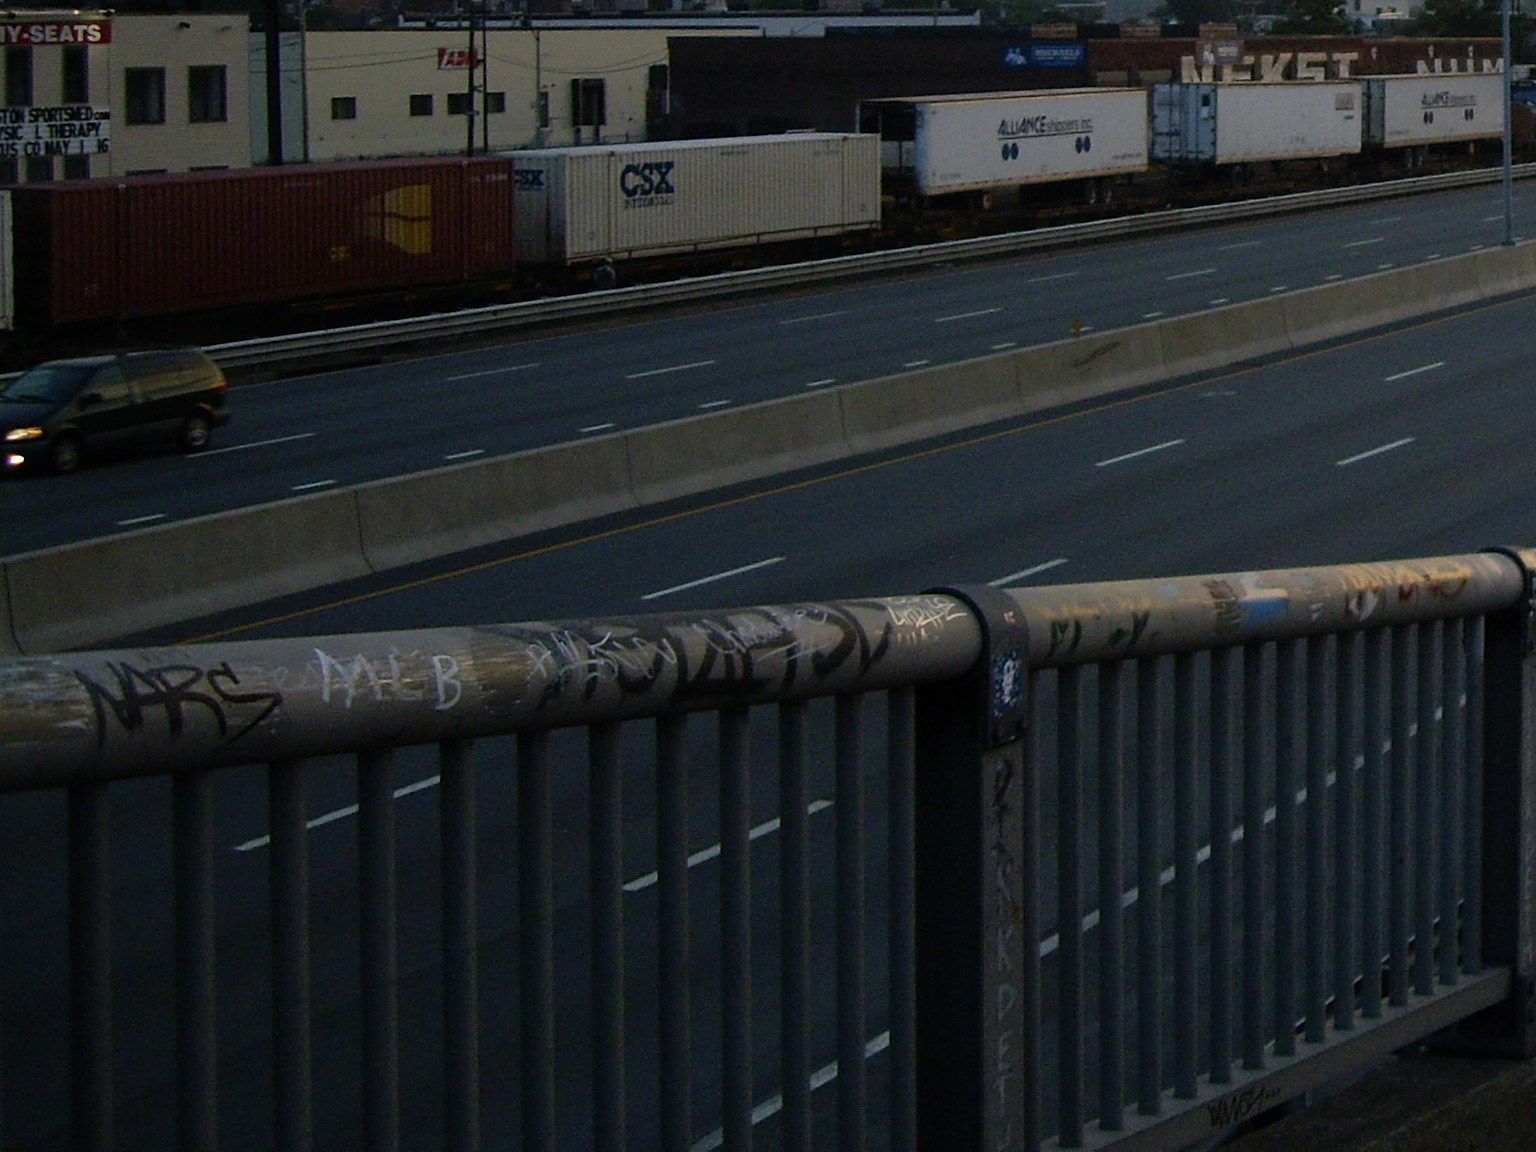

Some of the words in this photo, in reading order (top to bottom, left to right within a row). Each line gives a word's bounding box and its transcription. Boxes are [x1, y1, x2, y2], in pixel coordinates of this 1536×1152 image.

[47, 121, 102, 139] THERAPY
[998, 115, 1047, 136] ALLIANCE
[621, 161, 676, 197] CSX
